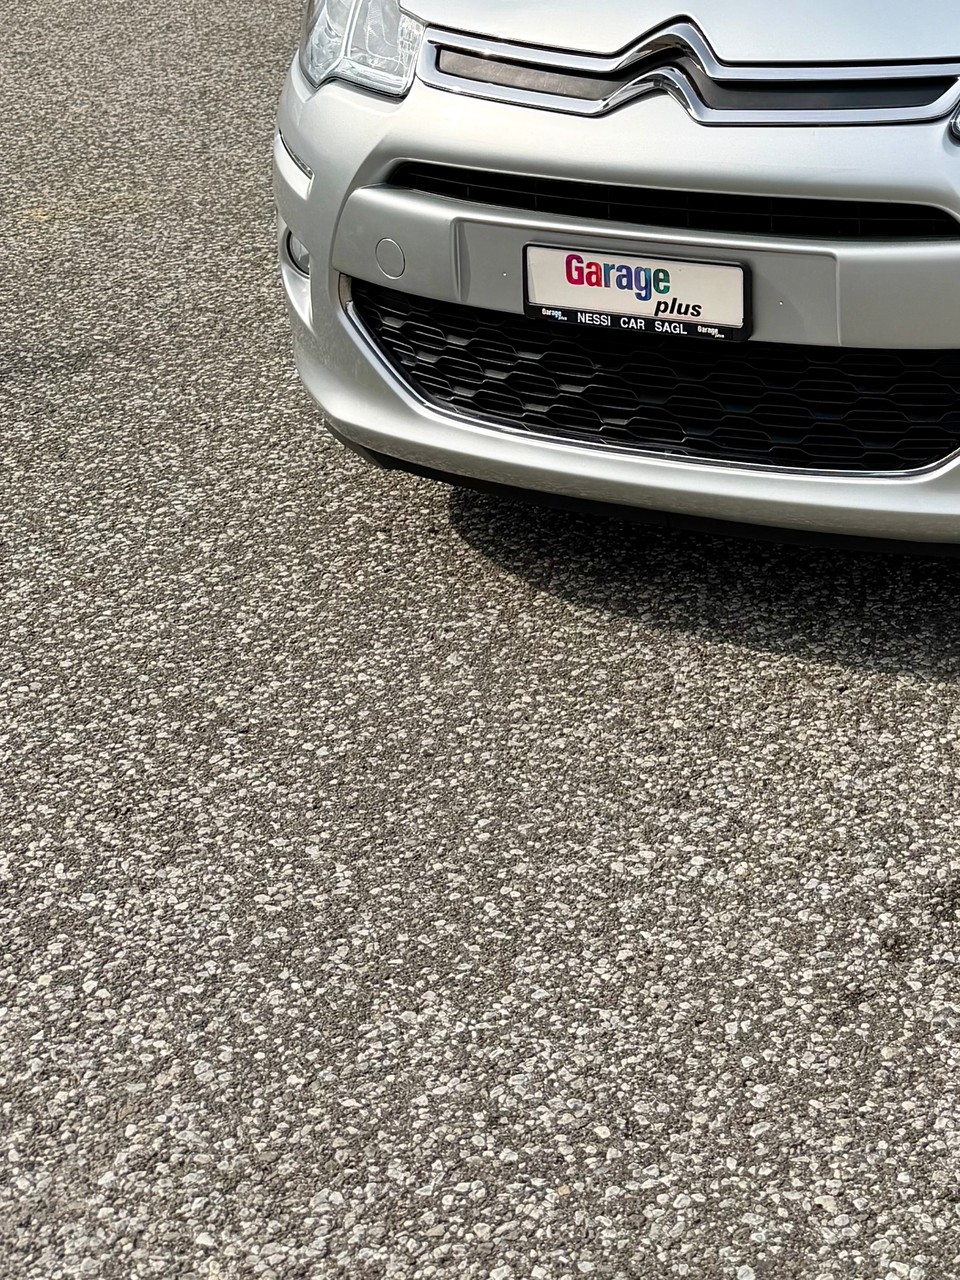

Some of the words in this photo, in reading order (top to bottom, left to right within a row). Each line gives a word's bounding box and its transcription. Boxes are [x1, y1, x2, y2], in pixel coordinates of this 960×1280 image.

[565, 253, 671, 301] Garage
[542, 308, 562, 318] Garage
[653, 297, 702, 317] plus
[577, 312, 611, 326] NESSI
[620, 317, 645, 330] CAR
[654, 321, 688, 335] SAGL
[697, 325, 719, 336] Garage
